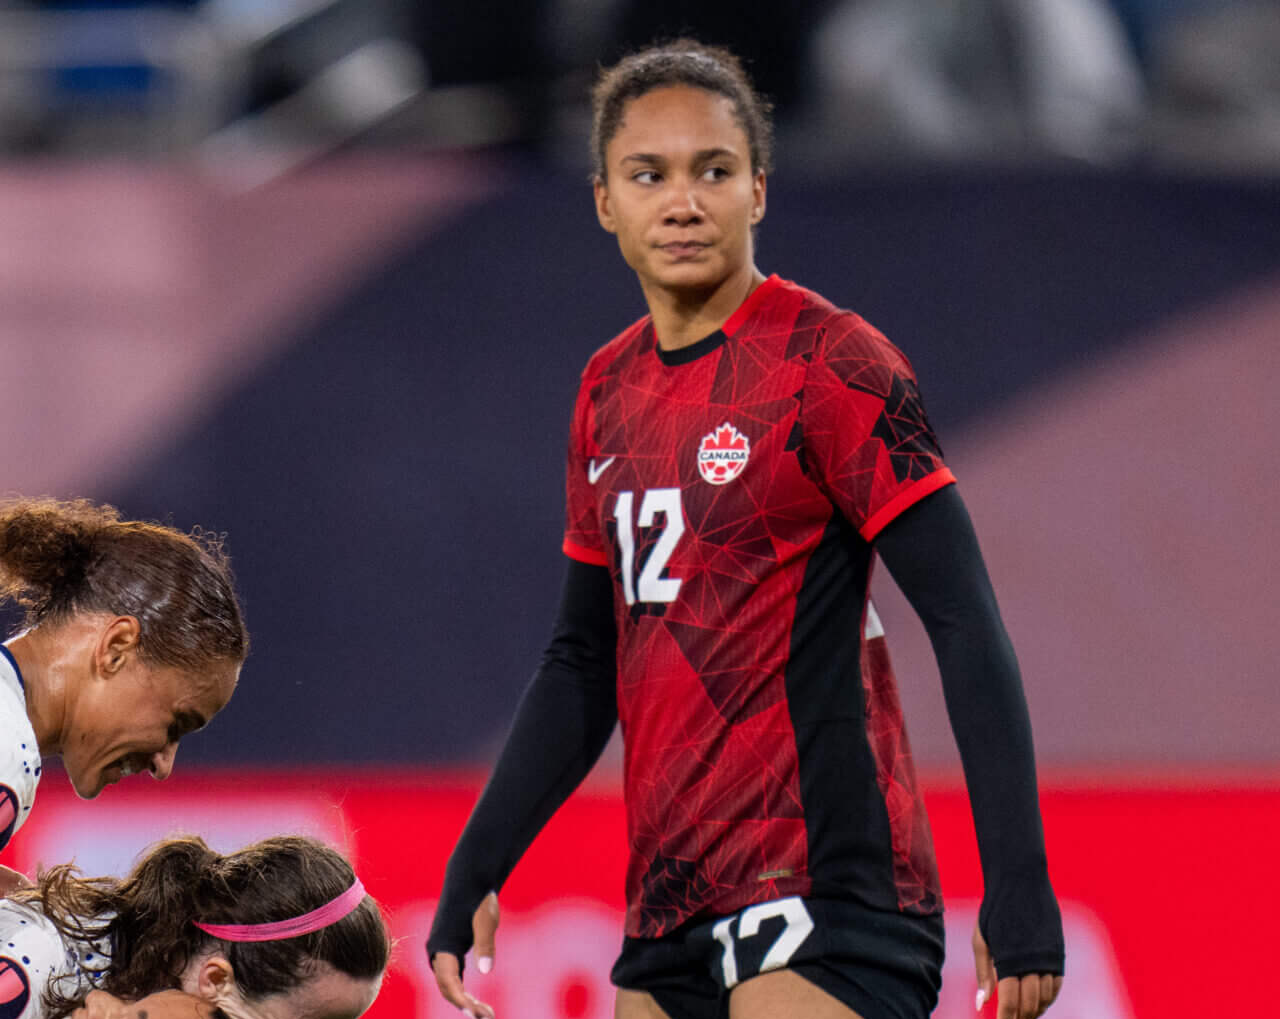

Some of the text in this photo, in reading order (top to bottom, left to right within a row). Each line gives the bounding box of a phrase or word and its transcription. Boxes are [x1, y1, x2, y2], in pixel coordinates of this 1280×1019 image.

[700, 451, 746, 461] CANADA
[614, 487, 685, 606] 12
[712, 897, 815, 989] 12
